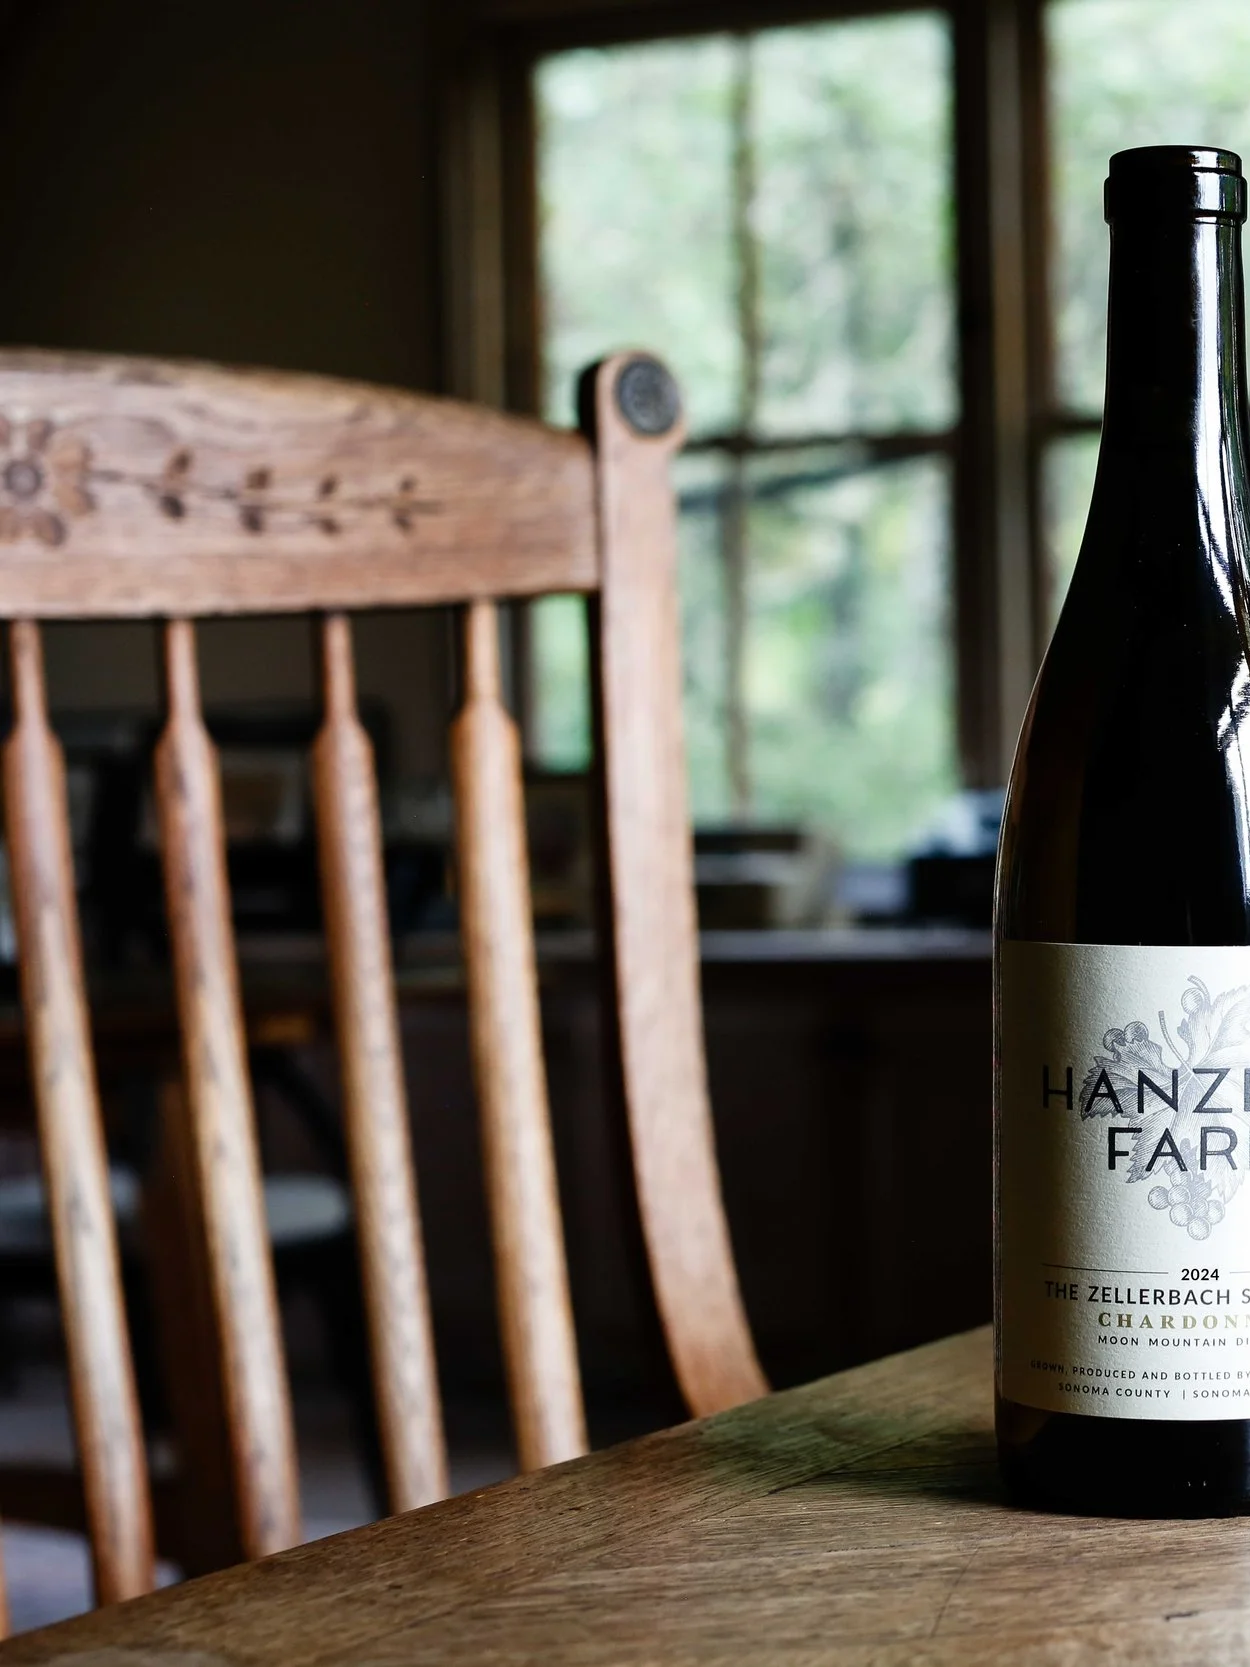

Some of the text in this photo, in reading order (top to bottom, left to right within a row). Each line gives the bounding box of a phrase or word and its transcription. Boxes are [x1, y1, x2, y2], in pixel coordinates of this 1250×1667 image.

[1181, 1268, 1220, 1281] 2024
[1045, 1280, 1079, 1301] THE
[1087, 1285, 1230, 1306] ZELLERBACH
[1098, 1335, 1139, 1346] MOON
[1149, 1337, 1226, 1347] MOUNTAIN
[1073, 1366, 1136, 1379] PRODUCED
[1141, 1371, 1168, 1380] AND
[1174, 1371, 1231, 1381] BOTTLED
[1237, 1370, 1250, 1380] BY
[1058, 1382, 1109, 1396] SONOMA
[1116, 1388, 1170, 1398] COUNTY
[1193, 1389, 1250, 1399] SONOMA
